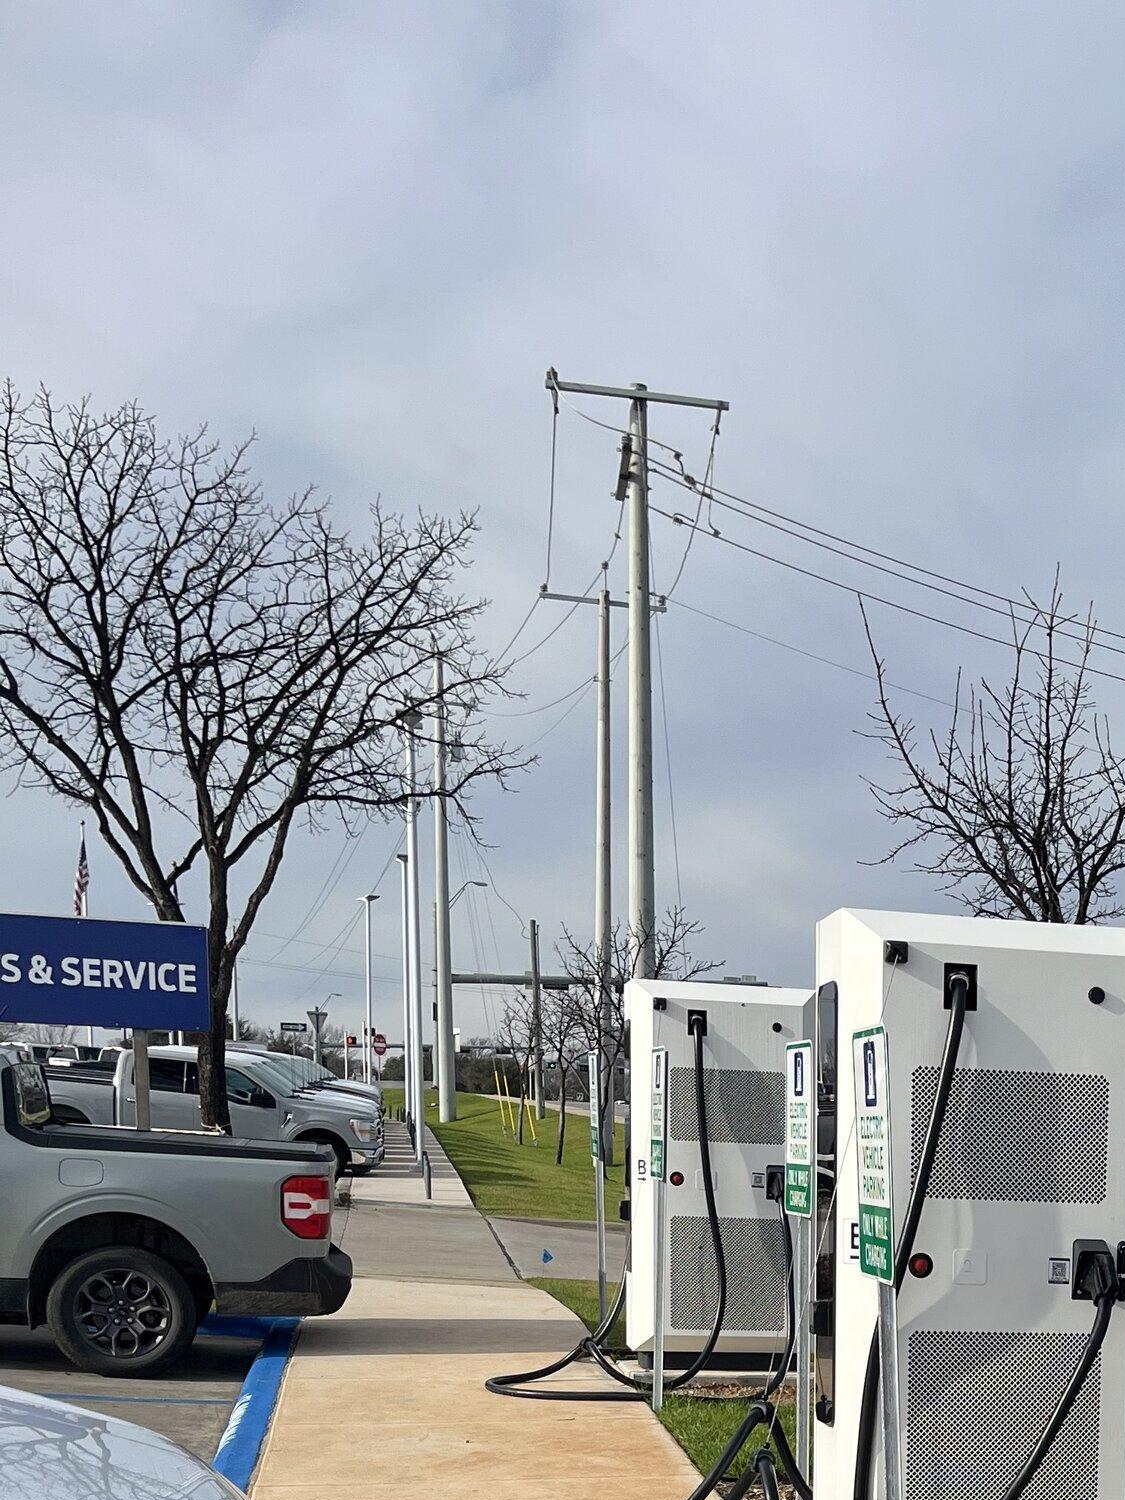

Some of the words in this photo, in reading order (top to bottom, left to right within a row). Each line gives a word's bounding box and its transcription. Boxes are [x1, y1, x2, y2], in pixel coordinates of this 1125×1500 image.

[28, 954, 54, 985] &
[61, 957, 197, 993] SERVICE
[860, 1116, 884, 1141] ELECTRIC
[638, 1160, 646, 1174] B
[862, 1146, 884, 1170] VEHICLE
[863, 1174, 885, 1201] PARKING
